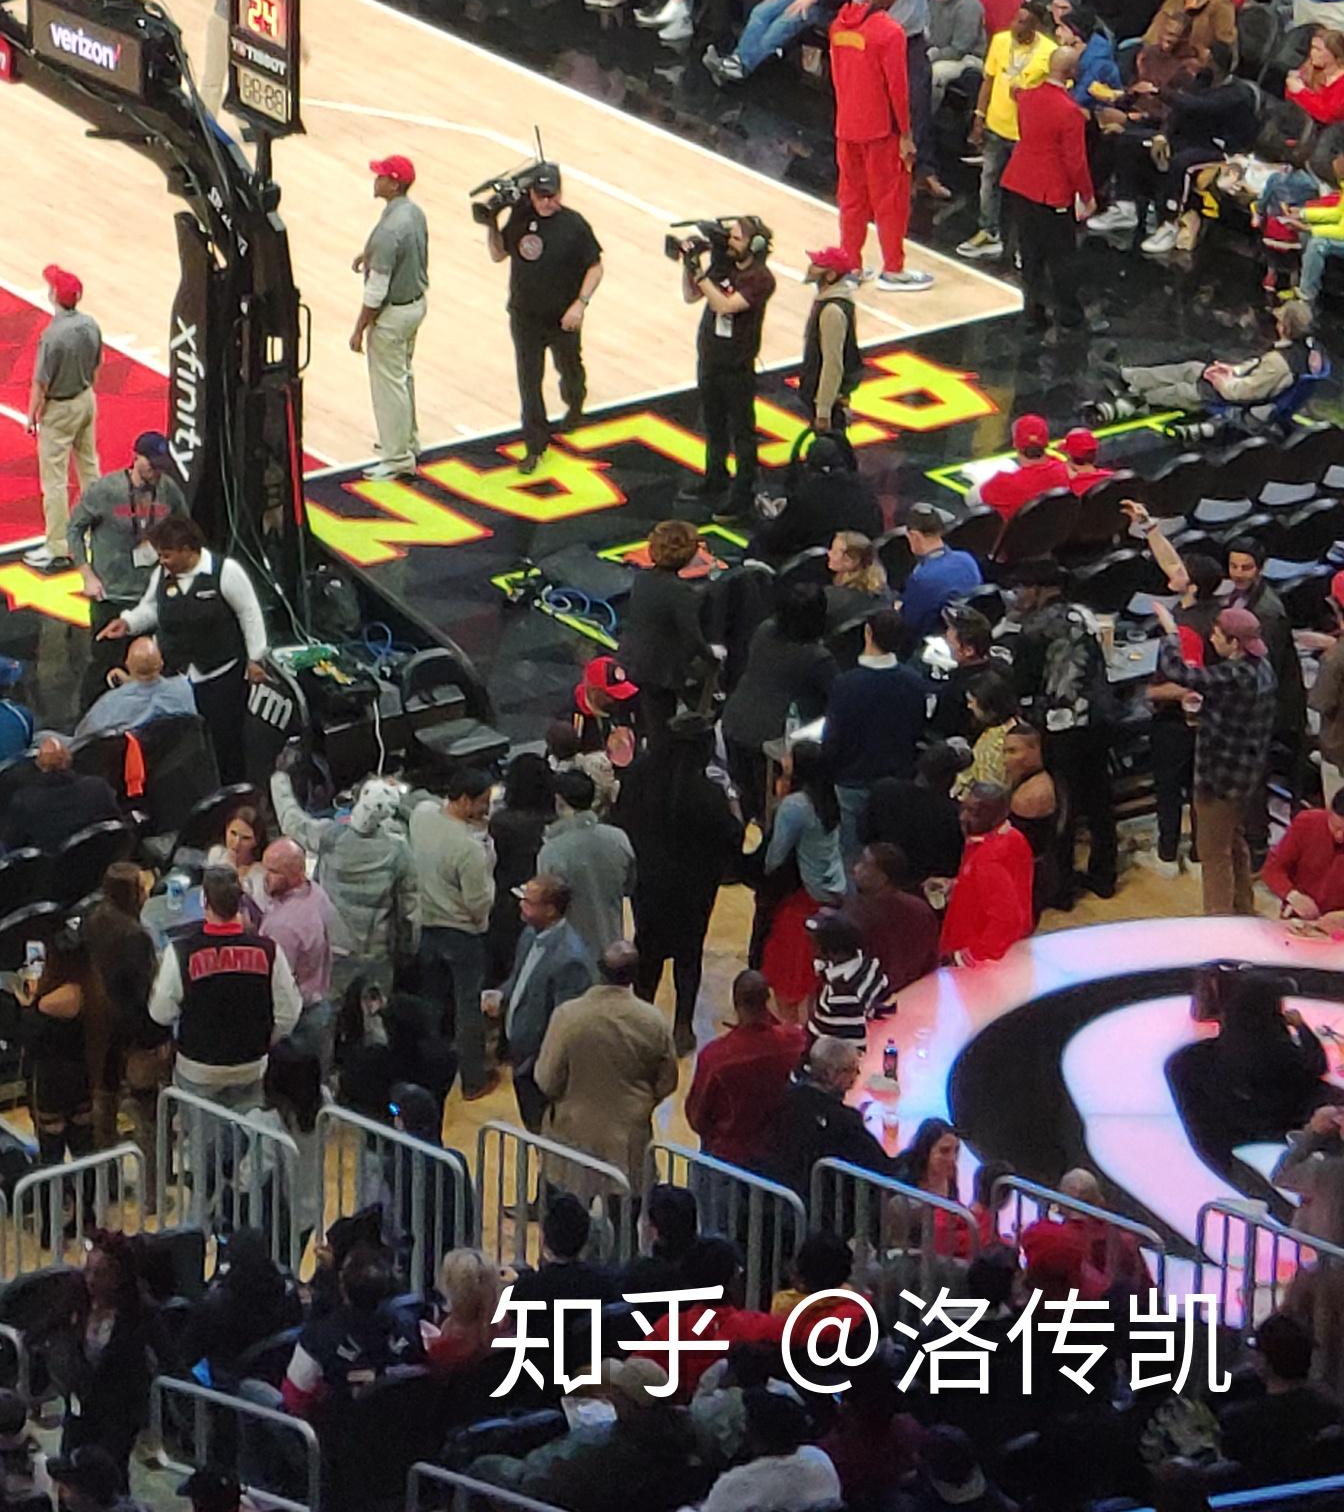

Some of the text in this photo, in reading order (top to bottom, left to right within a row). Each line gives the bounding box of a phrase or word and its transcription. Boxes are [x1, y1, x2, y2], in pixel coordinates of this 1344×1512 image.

[49, 21, 117, 72] verizon
[247, 44, 288, 76] TISSOT
[169, 315, 207, 483] xfinity
